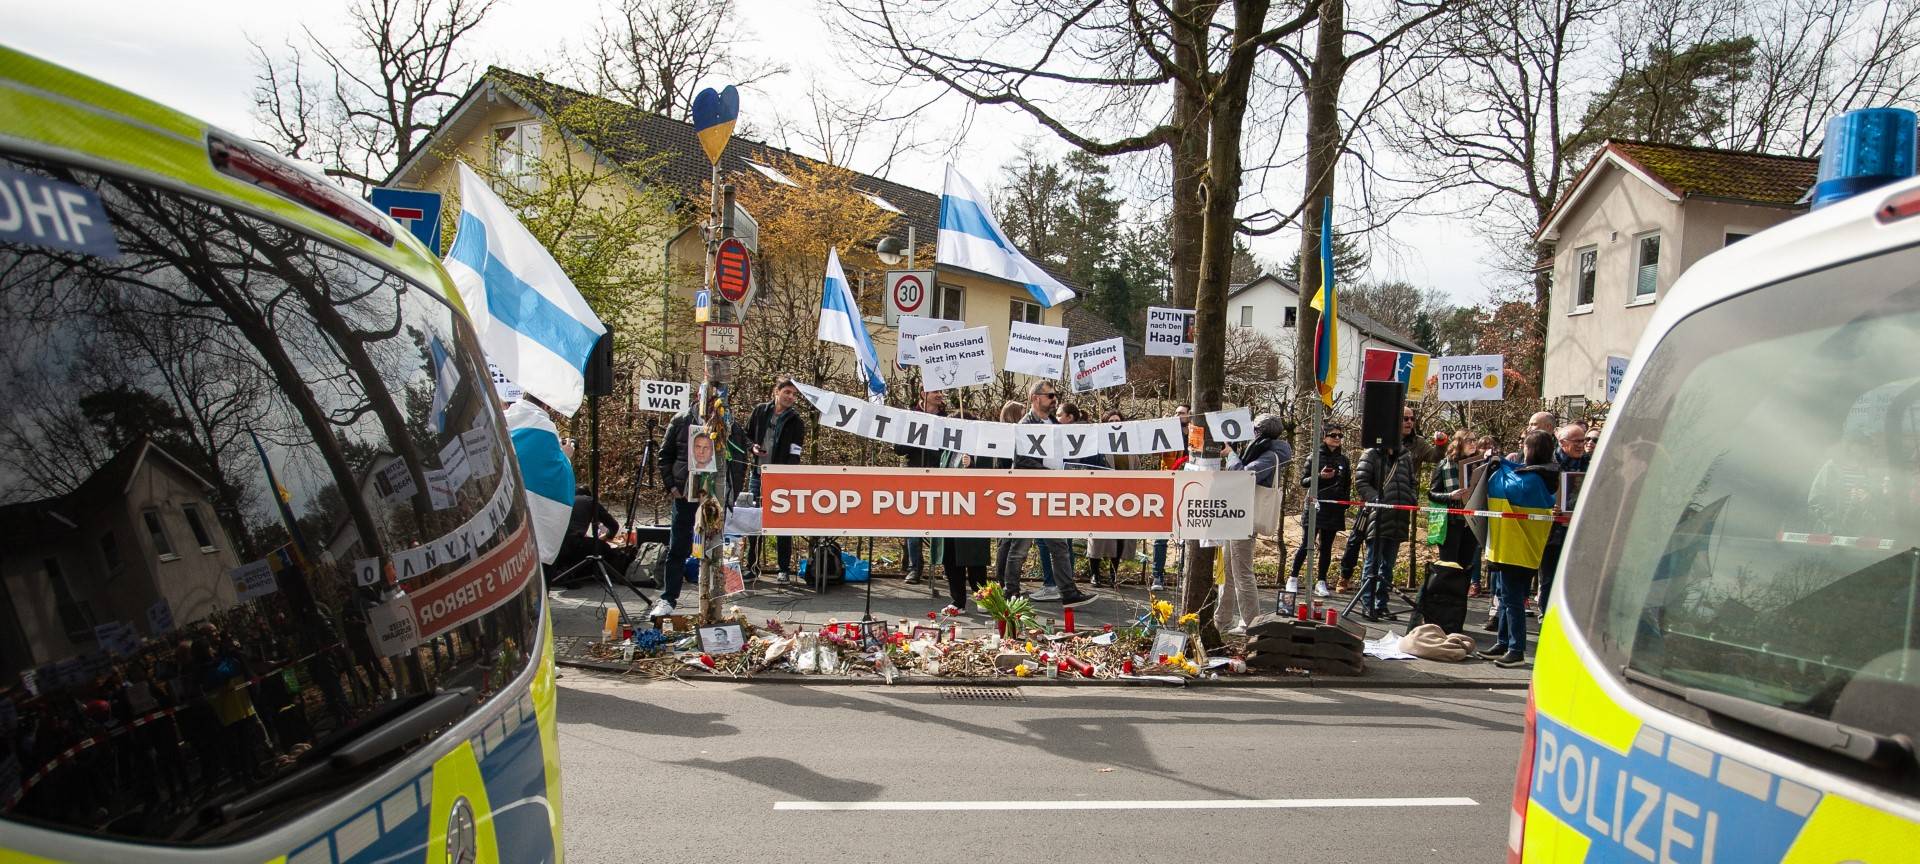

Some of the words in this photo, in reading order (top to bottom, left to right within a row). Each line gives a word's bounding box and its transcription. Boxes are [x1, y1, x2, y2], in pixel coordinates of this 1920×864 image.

[900, 285, 917, 302] 30
[1151, 311, 1182, 321] PUTIN
[920, 343, 942, 353] Mein
[943, 336, 984, 350] Russland
[1012, 332, 1041, 343] Präsident
[1047, 338, 1065, 347] Wahl
[1150, 331, 1181, 346] Haag
[925, 354, 944, 364] sitzt
[946, 353, 957, 361] im
[959, 349, 985, 359] Knast
[1010, 346, 1039, 356] Mafiaboss
[1044, 352, 1062, 360] Knast
[1073, 344, 1117, 360] Präsident
[1442, 364, 1482, 373] ПОЛДЕНЬ
[1610, 365, 1623, 376] Nie
[1442, 372, 1482, 381] ПРОТИВ
[646, 383, 684, 396] STOP
[1442, 381, 1482, 390] ПУТИНА
[648, 396, 681, 410] WAR
[769, 488, 861, 515] STOP
[1025, 492, 1164, 518] TERROR
[1187, 499, 1227, 509] FREIES
[1187, 509, 1246, 519] RUSSLAND
[1186, 518, 1213, 528] NRW
[1536, 729, 1719, 864] POLIZEI
